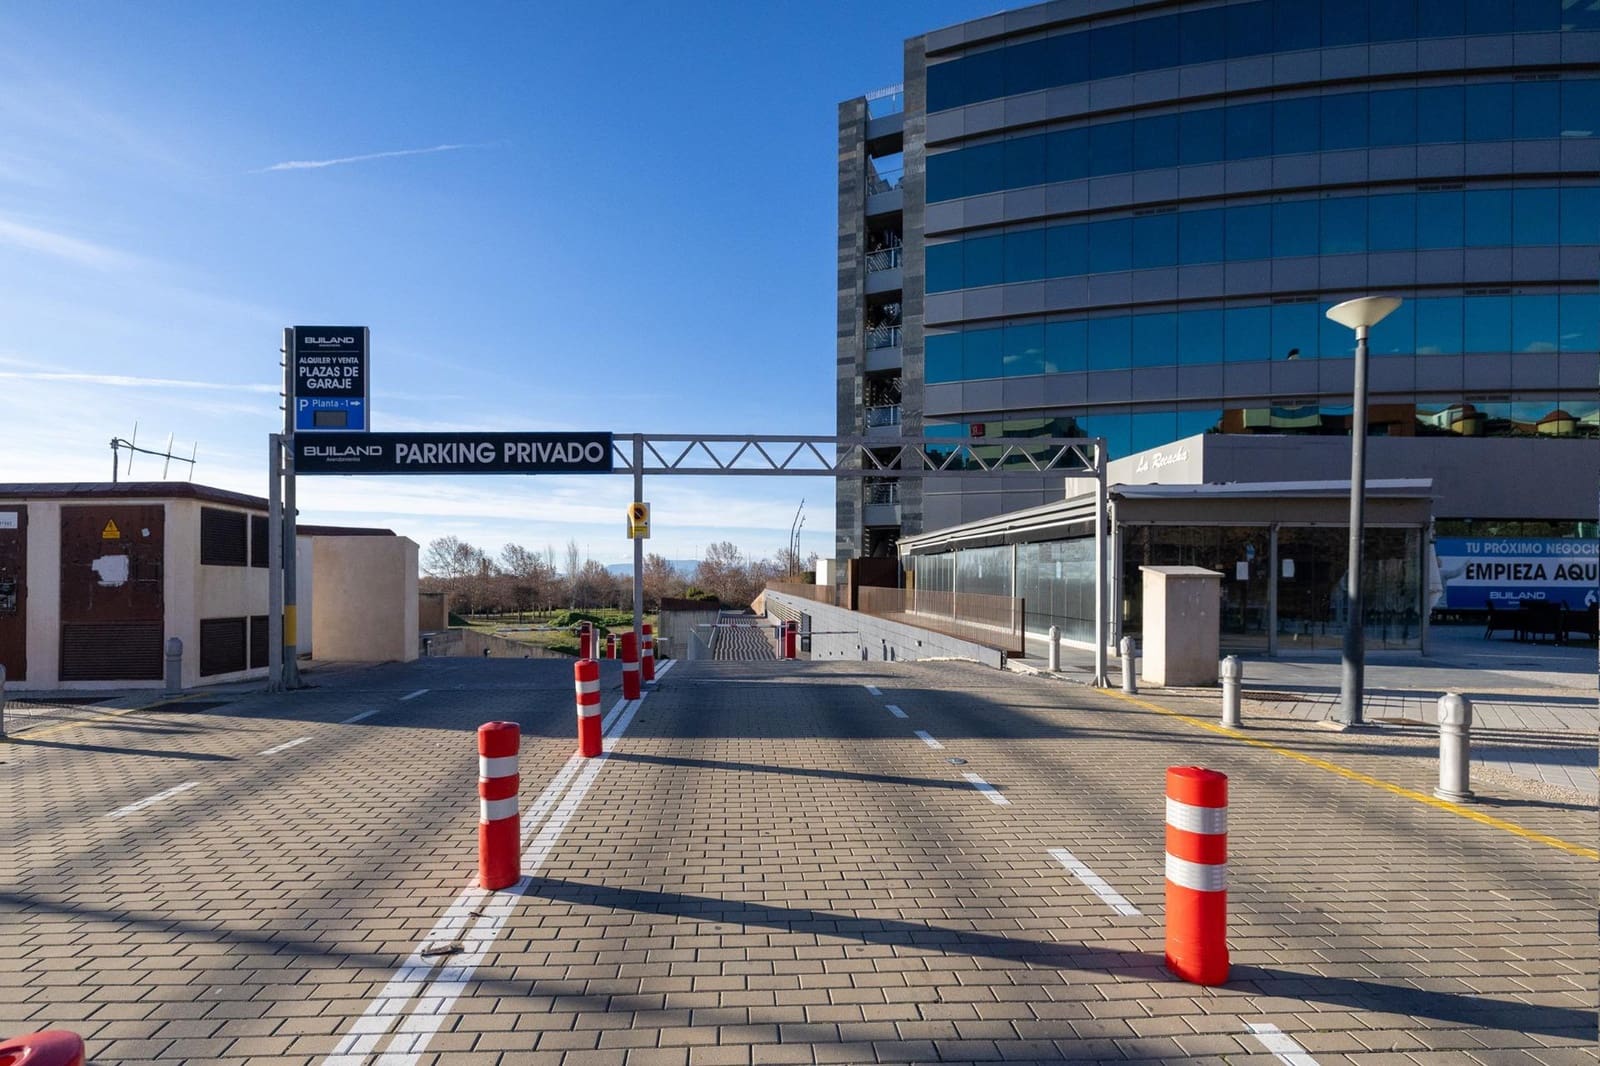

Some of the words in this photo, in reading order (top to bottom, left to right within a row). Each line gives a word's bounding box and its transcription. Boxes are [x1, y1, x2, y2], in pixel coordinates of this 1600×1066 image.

[299, 366, 341, 377] PLAZAS
[343, 366, 359, 377] DE
[306, 378, 352, 389] GARAJE
[299, 399, 309, 412] P
[312, 399, 339, 408] Planta
[303, 446, 383, 456] BUILAND
[394, 442, 496, 464] PARKING
[503, 441, 604, 464] PRIVADO
[1136, 456, 1149, 473] La
[1466, 542, 1480, 553] TU
[1484, 540, 1543, 554] PRÓXIMO
[1465, 562, 1548, 580] EMPIEZA
[1489, 591, 1546, 600] BUILAND
